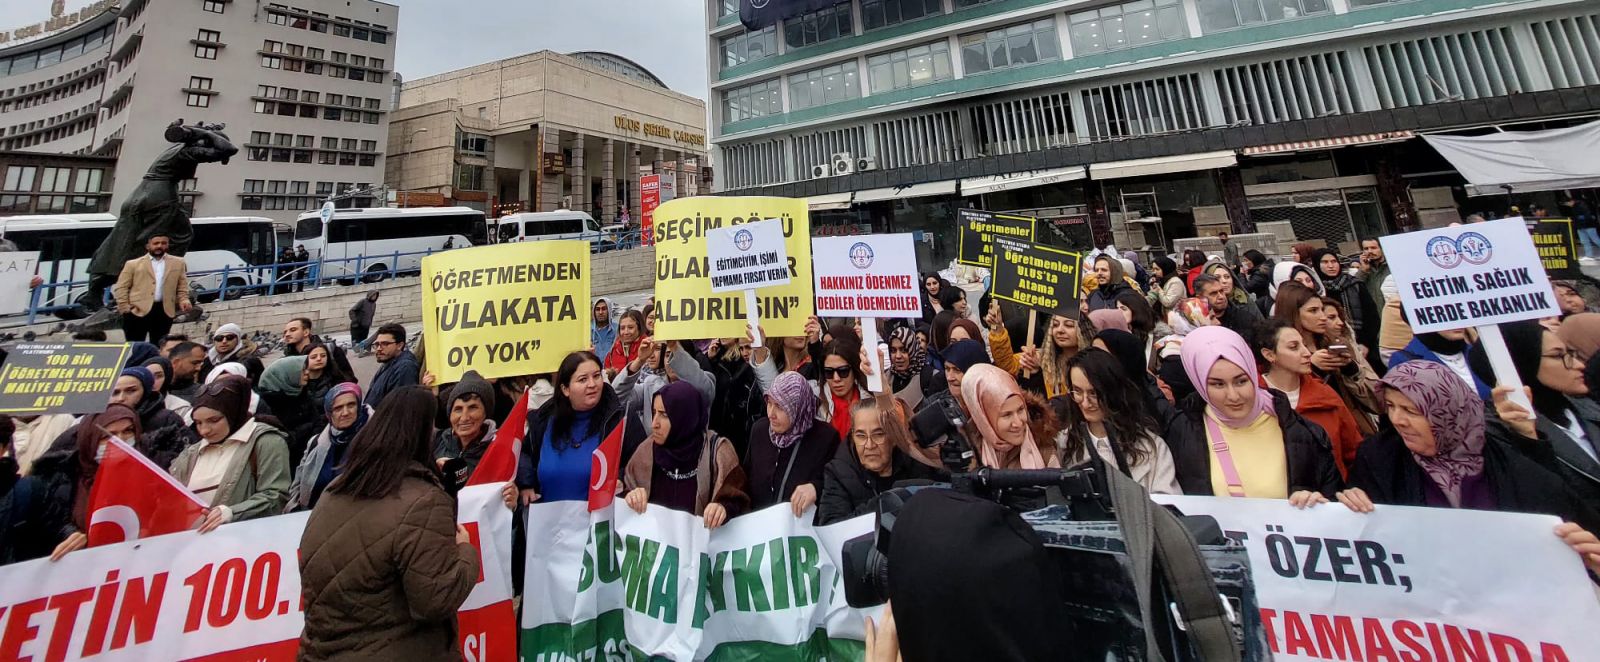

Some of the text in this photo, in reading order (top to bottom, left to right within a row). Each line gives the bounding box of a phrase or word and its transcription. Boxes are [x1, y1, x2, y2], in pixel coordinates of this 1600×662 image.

[614, 116, 640, 132] ULUS
[643, 123, 671, 139] ŞEHİR
[970, 220, 1030, 237] Öğretmenler
[0, 258, 36, 272] AT
[717, 249, 779, 271] EĞİTİMCİYİM, İŞİMİ
[1005, 250, 1074, 274] Öğretmenler
[711, 266, 788, 288] YAPMAMA FIRSAT VERİN
[820, 273, 912, 290] HAKKINIZ ÖDENMEZ
[1017, 265, 1058, 284] ULUS'ta
[1411, 267, 1534, 300] EĞİTİM, SAĞLIK
[1018, 278, 1055, 296] Atama
[817, 294, 919, 311] DEDİLER ÖDEMEDİLER
[1012, 289, 1058, 309] Nerede?
[1414, 291, 1551, 326] NERDE BAKANLIK
[436, 295, 578, 334] ÜLAKATA
[46, 353, 94, 366] 100 BİN
[447, 339, 541, 367] OY YOK”
[8, 366, 114, 380] ÖĞRETMEN HAZIR
[3, 379, 107, 394] MALİYE BÜTÇEYİ
[33, 396, 65, 407] AYIR
[1265, 524, 1413, 593] ÖZER;
[0, 551, 290, 662] ETİN 100.
